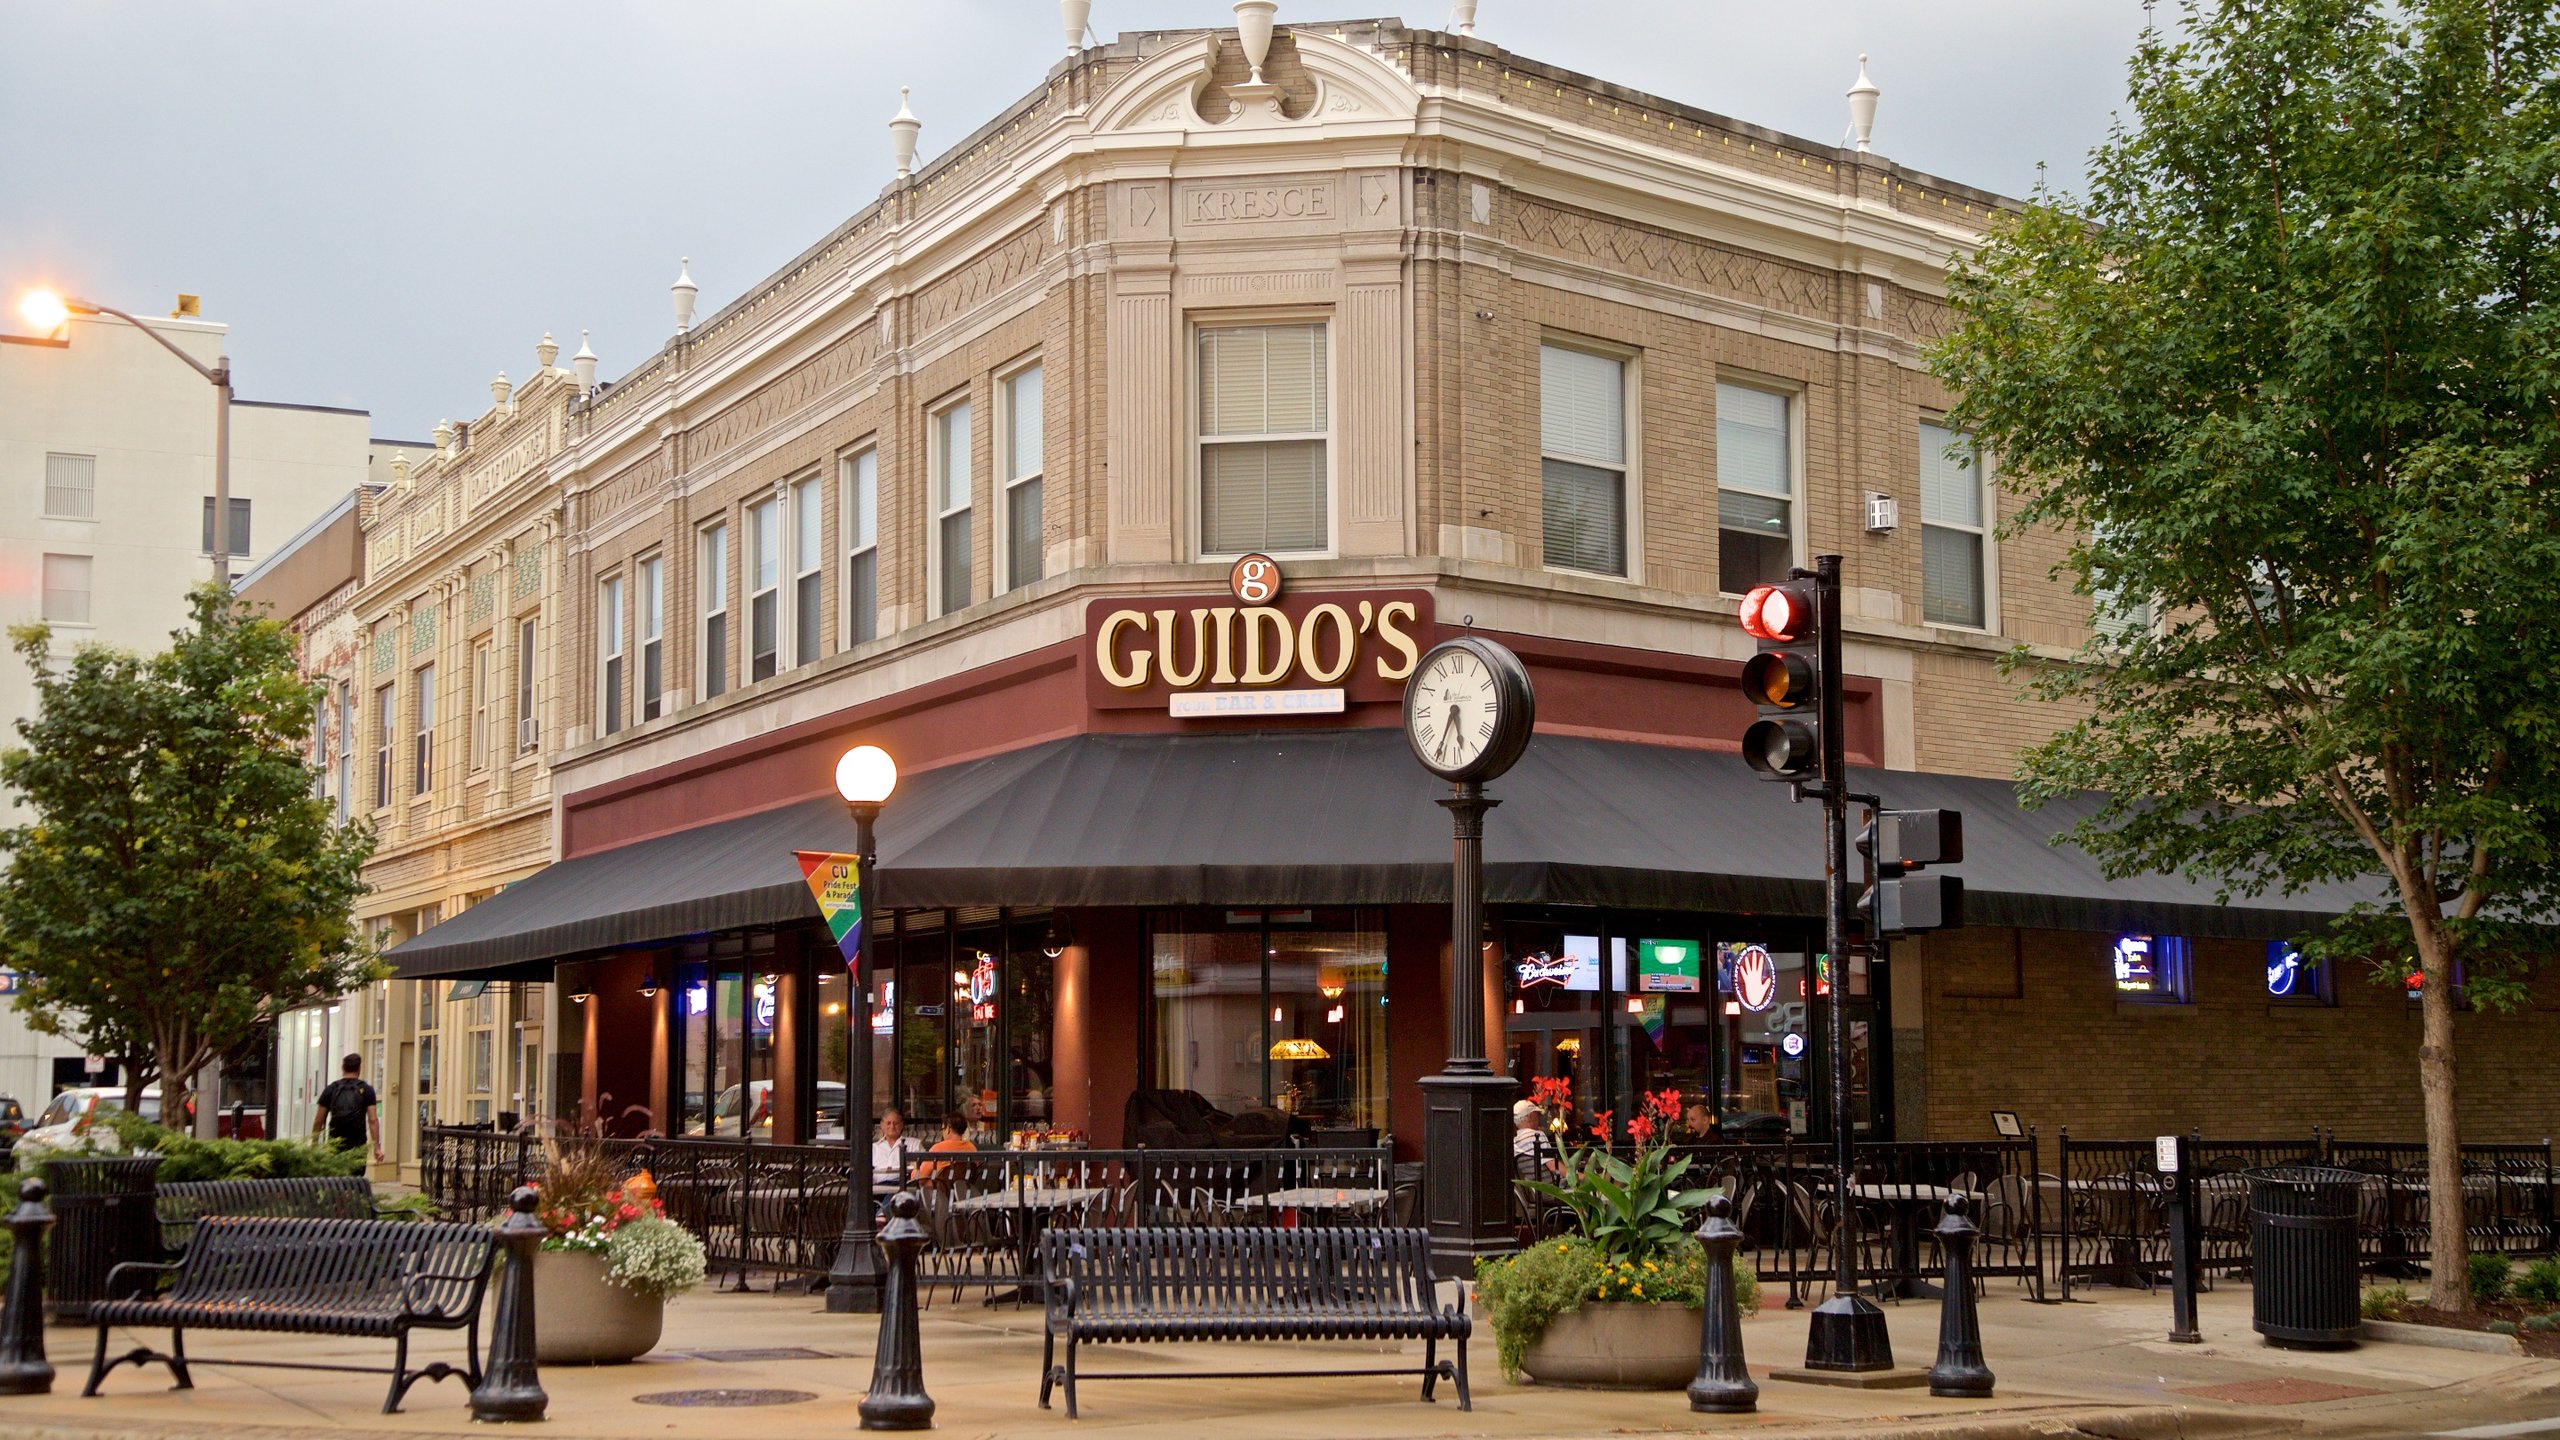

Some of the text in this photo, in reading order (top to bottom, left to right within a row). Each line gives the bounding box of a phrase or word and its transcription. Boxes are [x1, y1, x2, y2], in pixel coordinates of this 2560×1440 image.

[1240, 560, 1271, 601] g
[1096, 600, 1418, 687] GUIDO'S
[1434, 661, 1448, 682] XI
[1451, 655, 1463, 675] XII
[1421, 682, 1436, 697] X
[1215, 695, 1257, 711] BAR
[1263, 694, 1276, 710] &
[1281, 692, 1341, 709] GRILL
[831, 865, 849, 879] CU
[823, 880, 857, 890] Pride Fest
[832, 890, 855, 900] Parade
[1518, 963, 1575, 981] Budweiser
